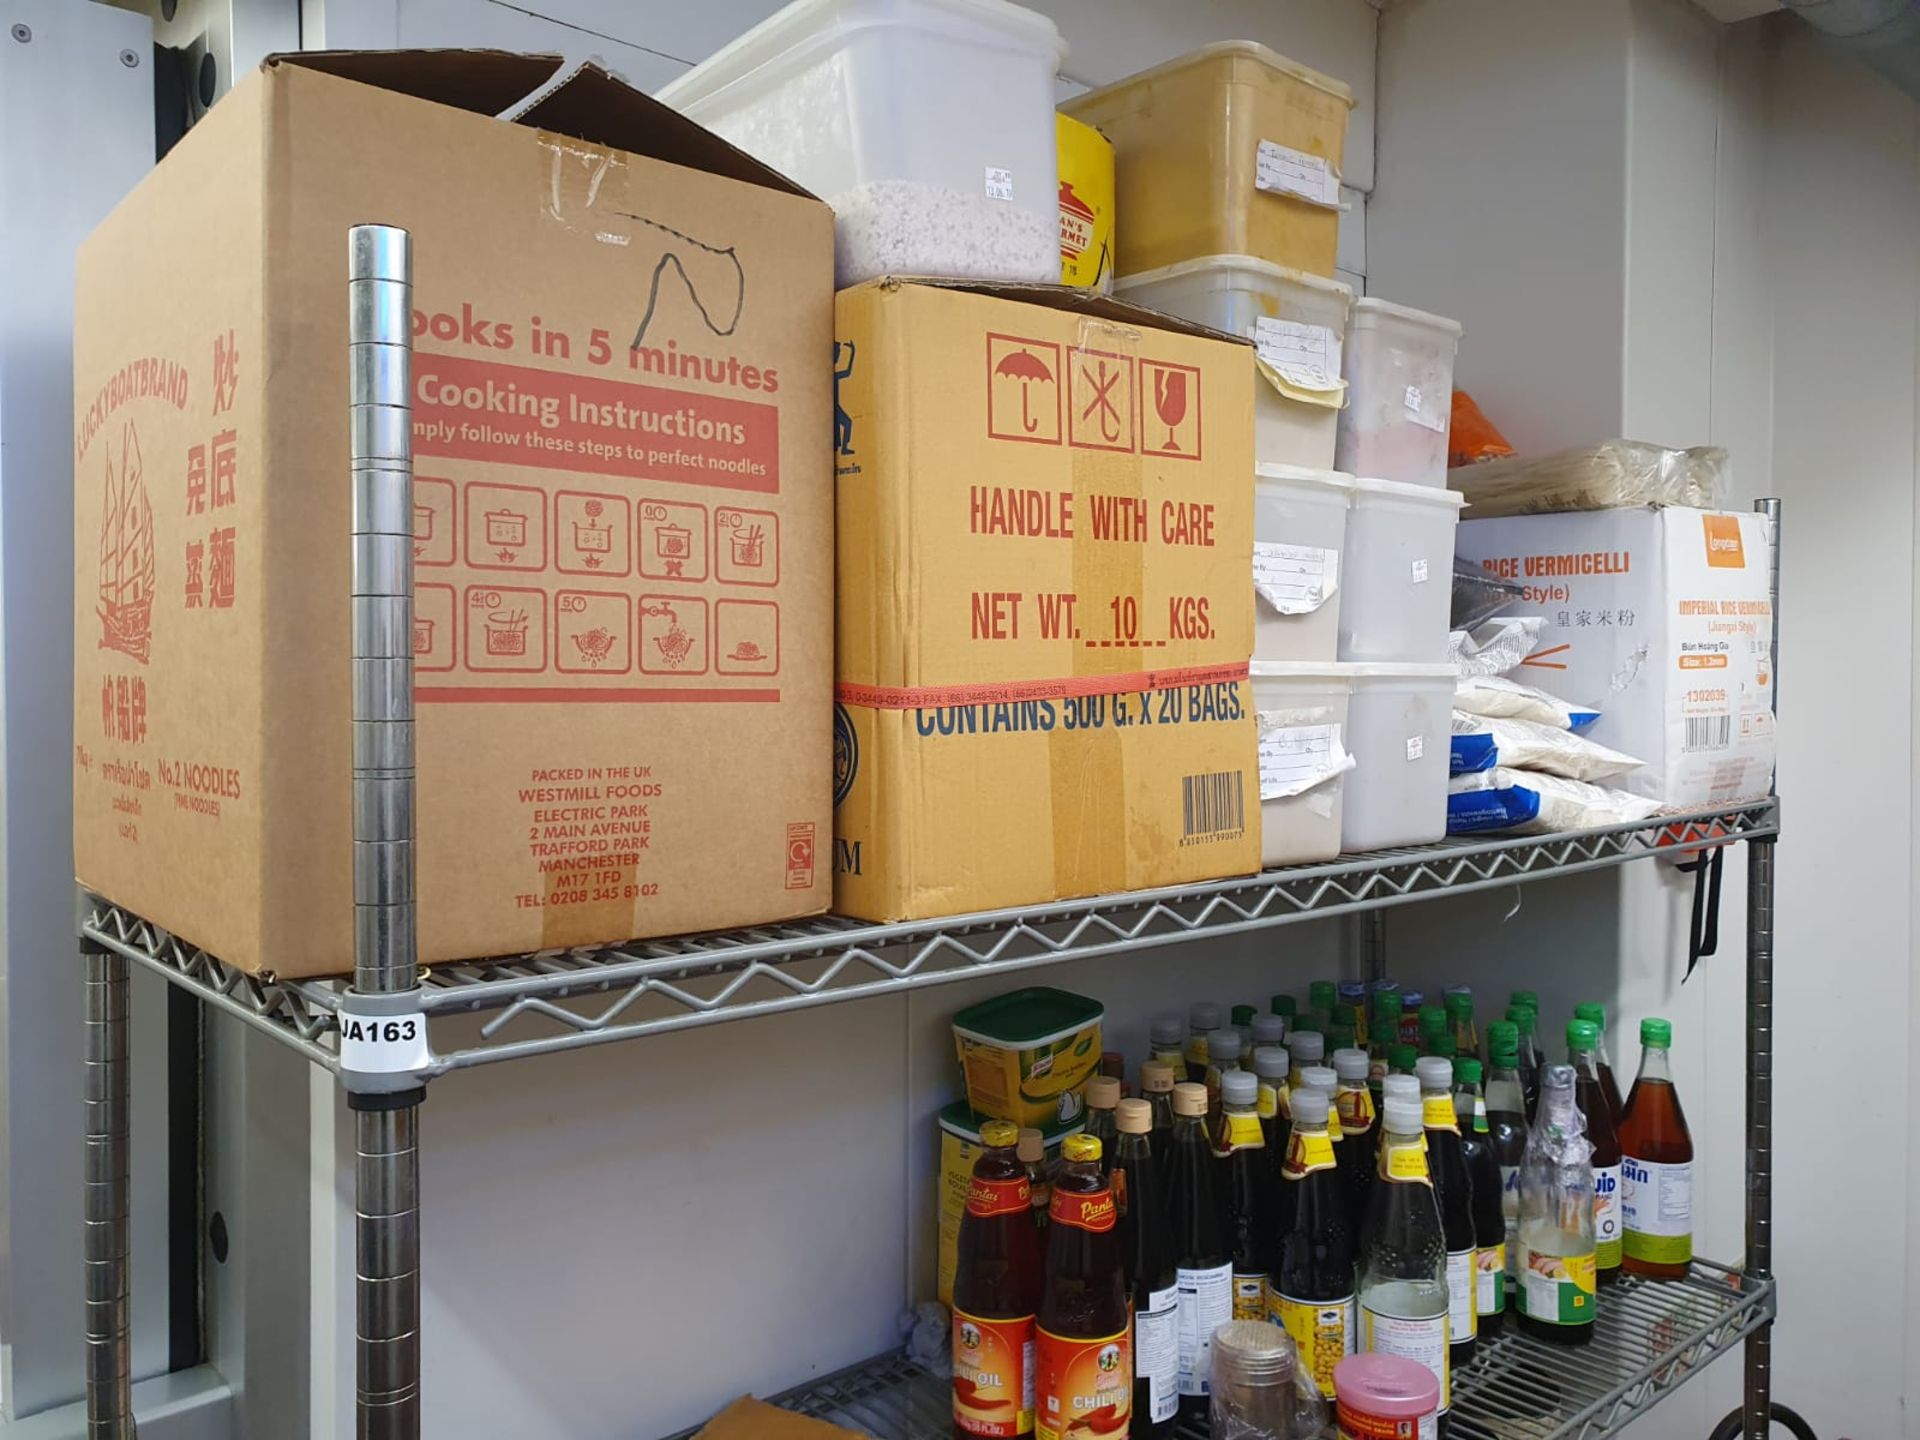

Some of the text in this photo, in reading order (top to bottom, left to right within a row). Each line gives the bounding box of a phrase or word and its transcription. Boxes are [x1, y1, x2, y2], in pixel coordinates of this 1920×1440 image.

[1060, 217, 1083, 233] AN'S
[1061, 228, 1088, 247] RMET
[412, 303, 779, 393] ooks in 5 minutes
[417, 374, 746, 446] Cooking Instructions
[460, 419, 521, 446] follow
[525, 431, 574, 453] these
[577, 438, 623, 461] steps
[625, 445, 644, 461] to
[648, 447, 704, 471] perfect
[708, 456, 767, 477] noodles
[970, 485, 1215, 546] HANDLE WITH CARE
[1525, 551, 1630, 577] VERMICELLI
[1522, 584, 1571, 604] Style)
[972, 592, 1215, 640] NET WT. 10 KGS.
[916, 702, 1056, 736] CONTAINS
[1063, 692, 1105, 729] 500
[1158, 686, 1182, 723] 20
[1188, 681, 1245, 722] BAGS.
[158, 758, 241, 800] No.2 NOODLES
[532, 766, 651, 782] PACKED IN THE UK
[518, 784, 662, 803] WESTMILL FOODS
[534, 804, 648, 823] ELECTRIC PARK
[530, 821, 651, 840] 2 MAIN AVENUE
[530, 837, 650, 857] TRAFFORD PARK
[538, 853, 640, 873] MANCHESTER
[556, 871, 621, 889] M17 1FD
[515, 883, 659, 908] TEL: 0208 345 8102
[977, 1372, 1003, 1386] OIL
